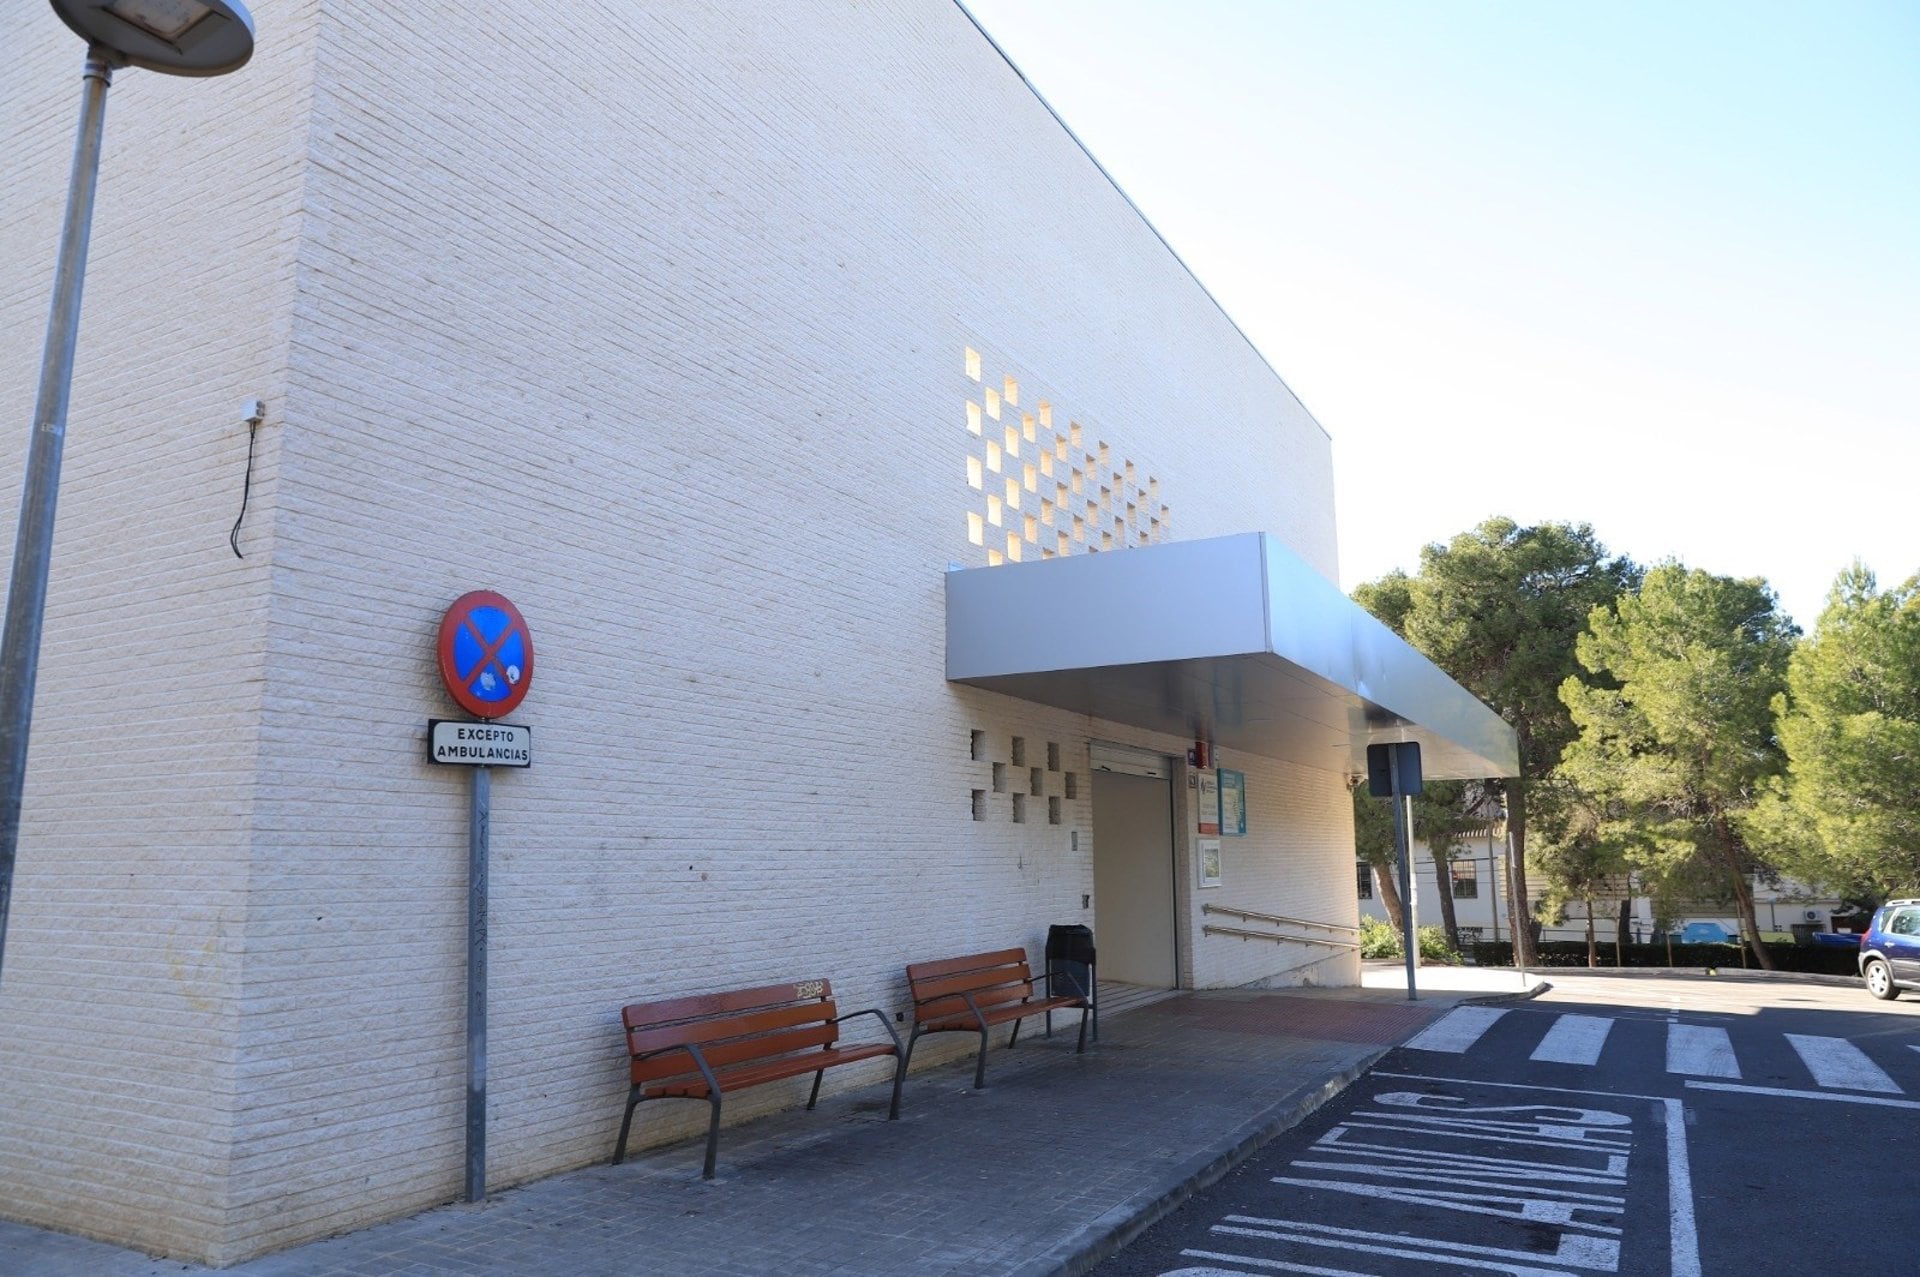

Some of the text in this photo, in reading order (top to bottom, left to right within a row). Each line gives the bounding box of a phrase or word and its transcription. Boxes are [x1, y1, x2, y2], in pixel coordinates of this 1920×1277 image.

[457, 728, 514, 742] EXCEPTO
[437, 745, 528, 761] AMBULANCIAS
[1157, 1091, 1633, 1277] ULANCIAS
